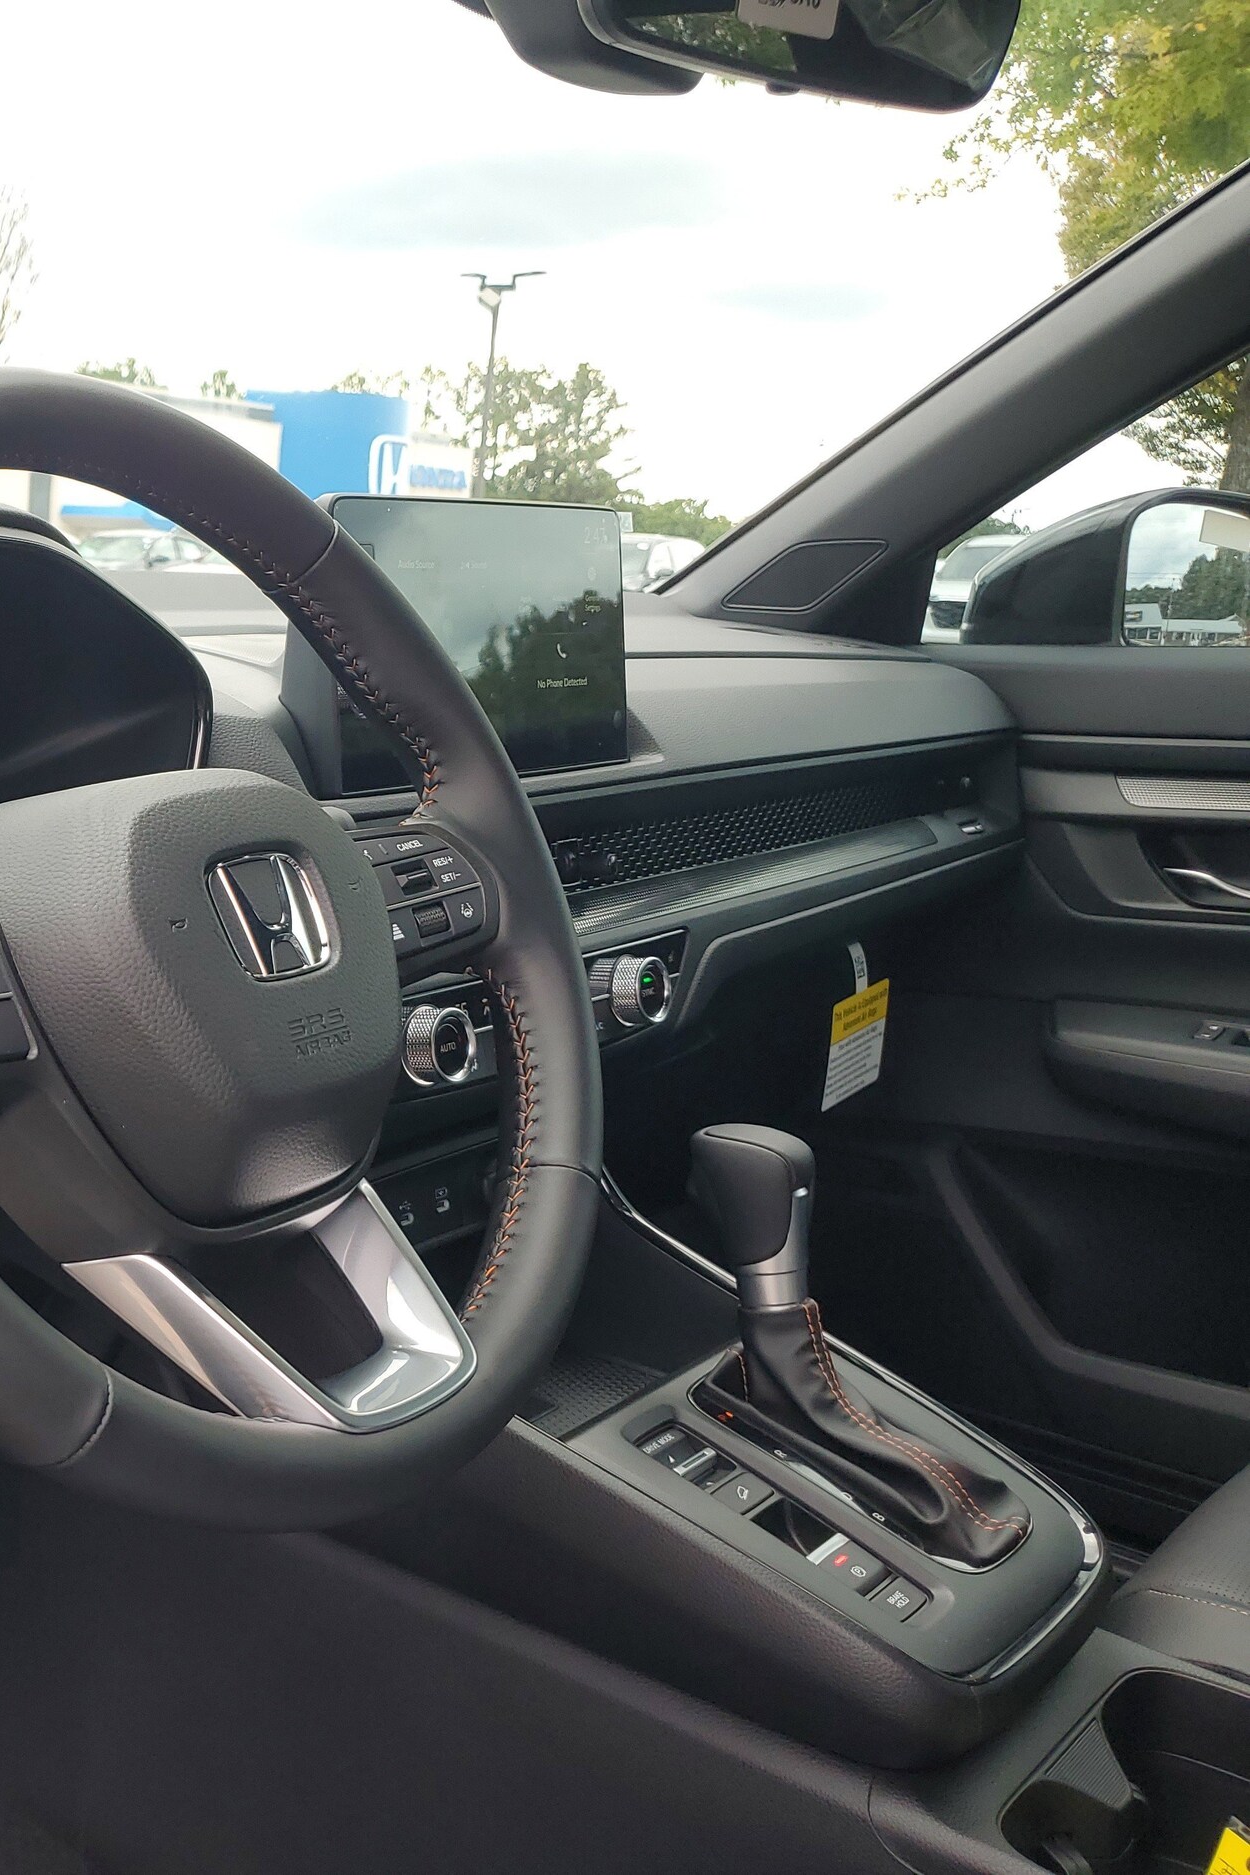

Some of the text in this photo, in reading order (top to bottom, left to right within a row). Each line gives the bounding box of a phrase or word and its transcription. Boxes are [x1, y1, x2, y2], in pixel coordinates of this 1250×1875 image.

[537, 676, 588, 689] No Phone Detected
[396, 839, 423, 852] CANCEL
[432, 855, 454, 868] RES/+
[287, 1007, 346, 1037] SRS
[440, 1041, 457, 1053] AUTO
[642, 1433, 675, 1454] DRIVE MODE
[773, 1449, 788, 1460] R
[871, 1512, 886, 1522] B
[886, 1590, 905, 1605] BRAKE
[894, 1596, 910, 1609] HOLD
